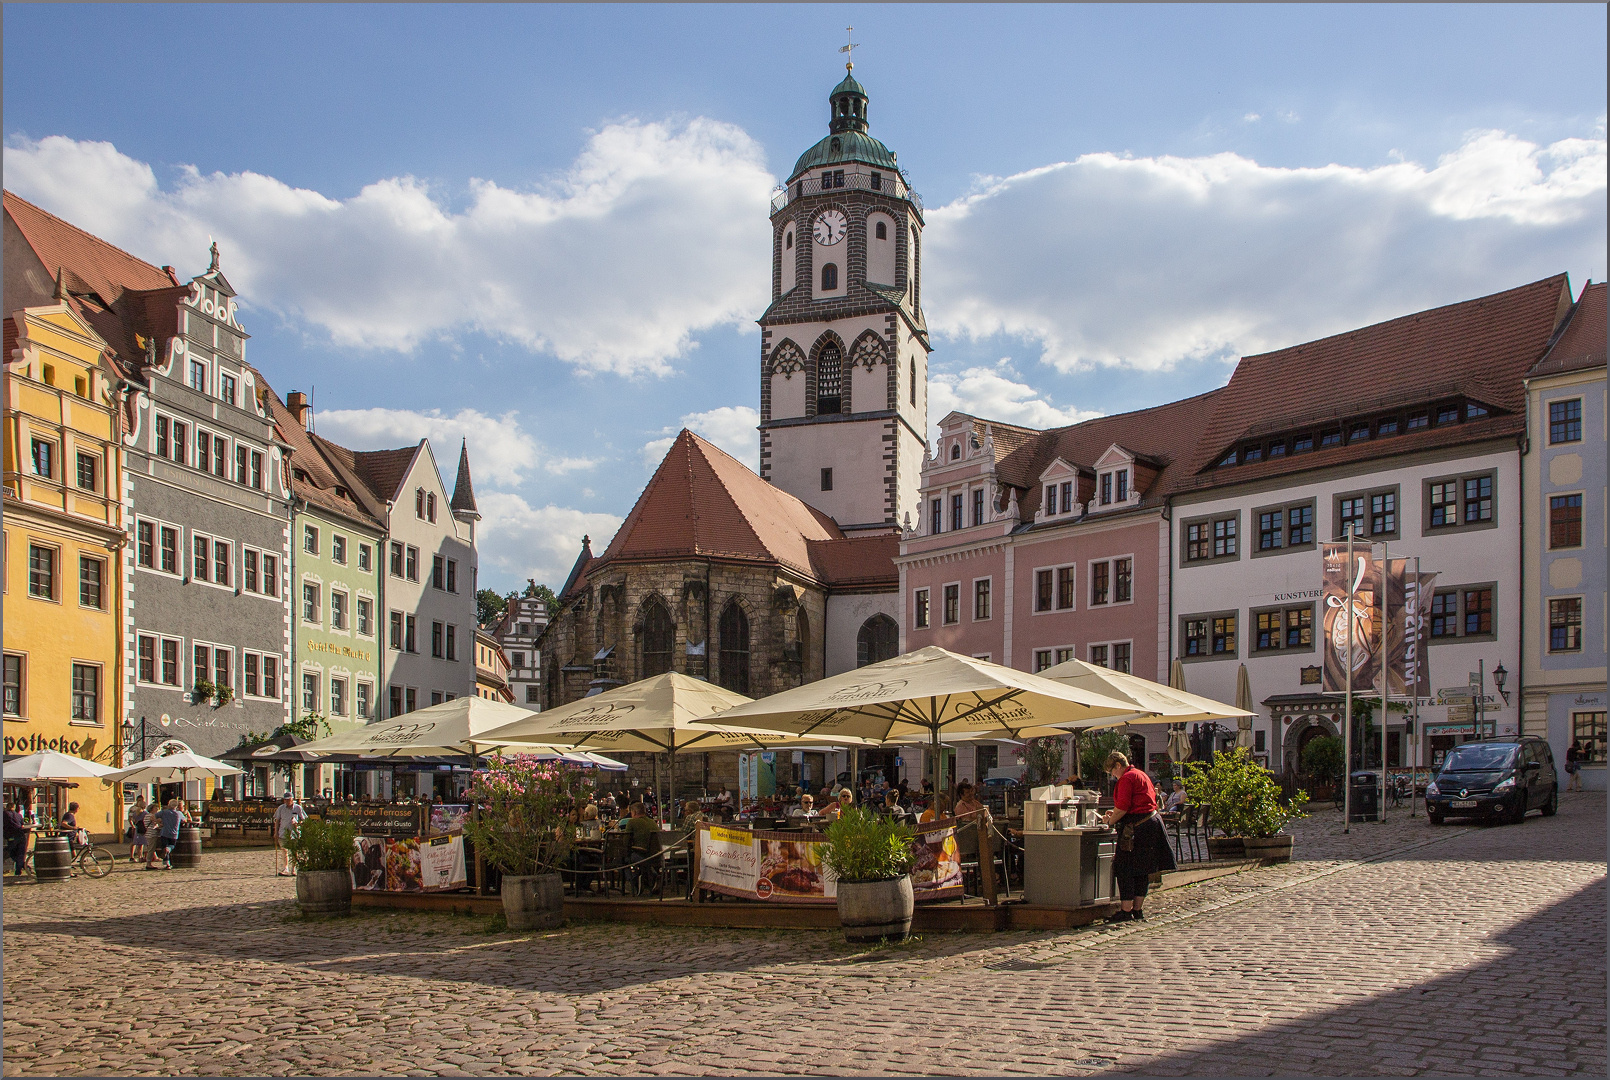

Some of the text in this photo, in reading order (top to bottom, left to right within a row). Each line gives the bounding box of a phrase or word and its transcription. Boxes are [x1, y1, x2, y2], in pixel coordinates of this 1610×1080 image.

[307, 640, 328, 653] Hotel
[208, 804, 228, 812] Essen
[230, 804, 243, 813] auf
[244, 804, 256, 813] der
[364, 808, 377, 816] der
[379, 808, 412, 816] Terrasse
